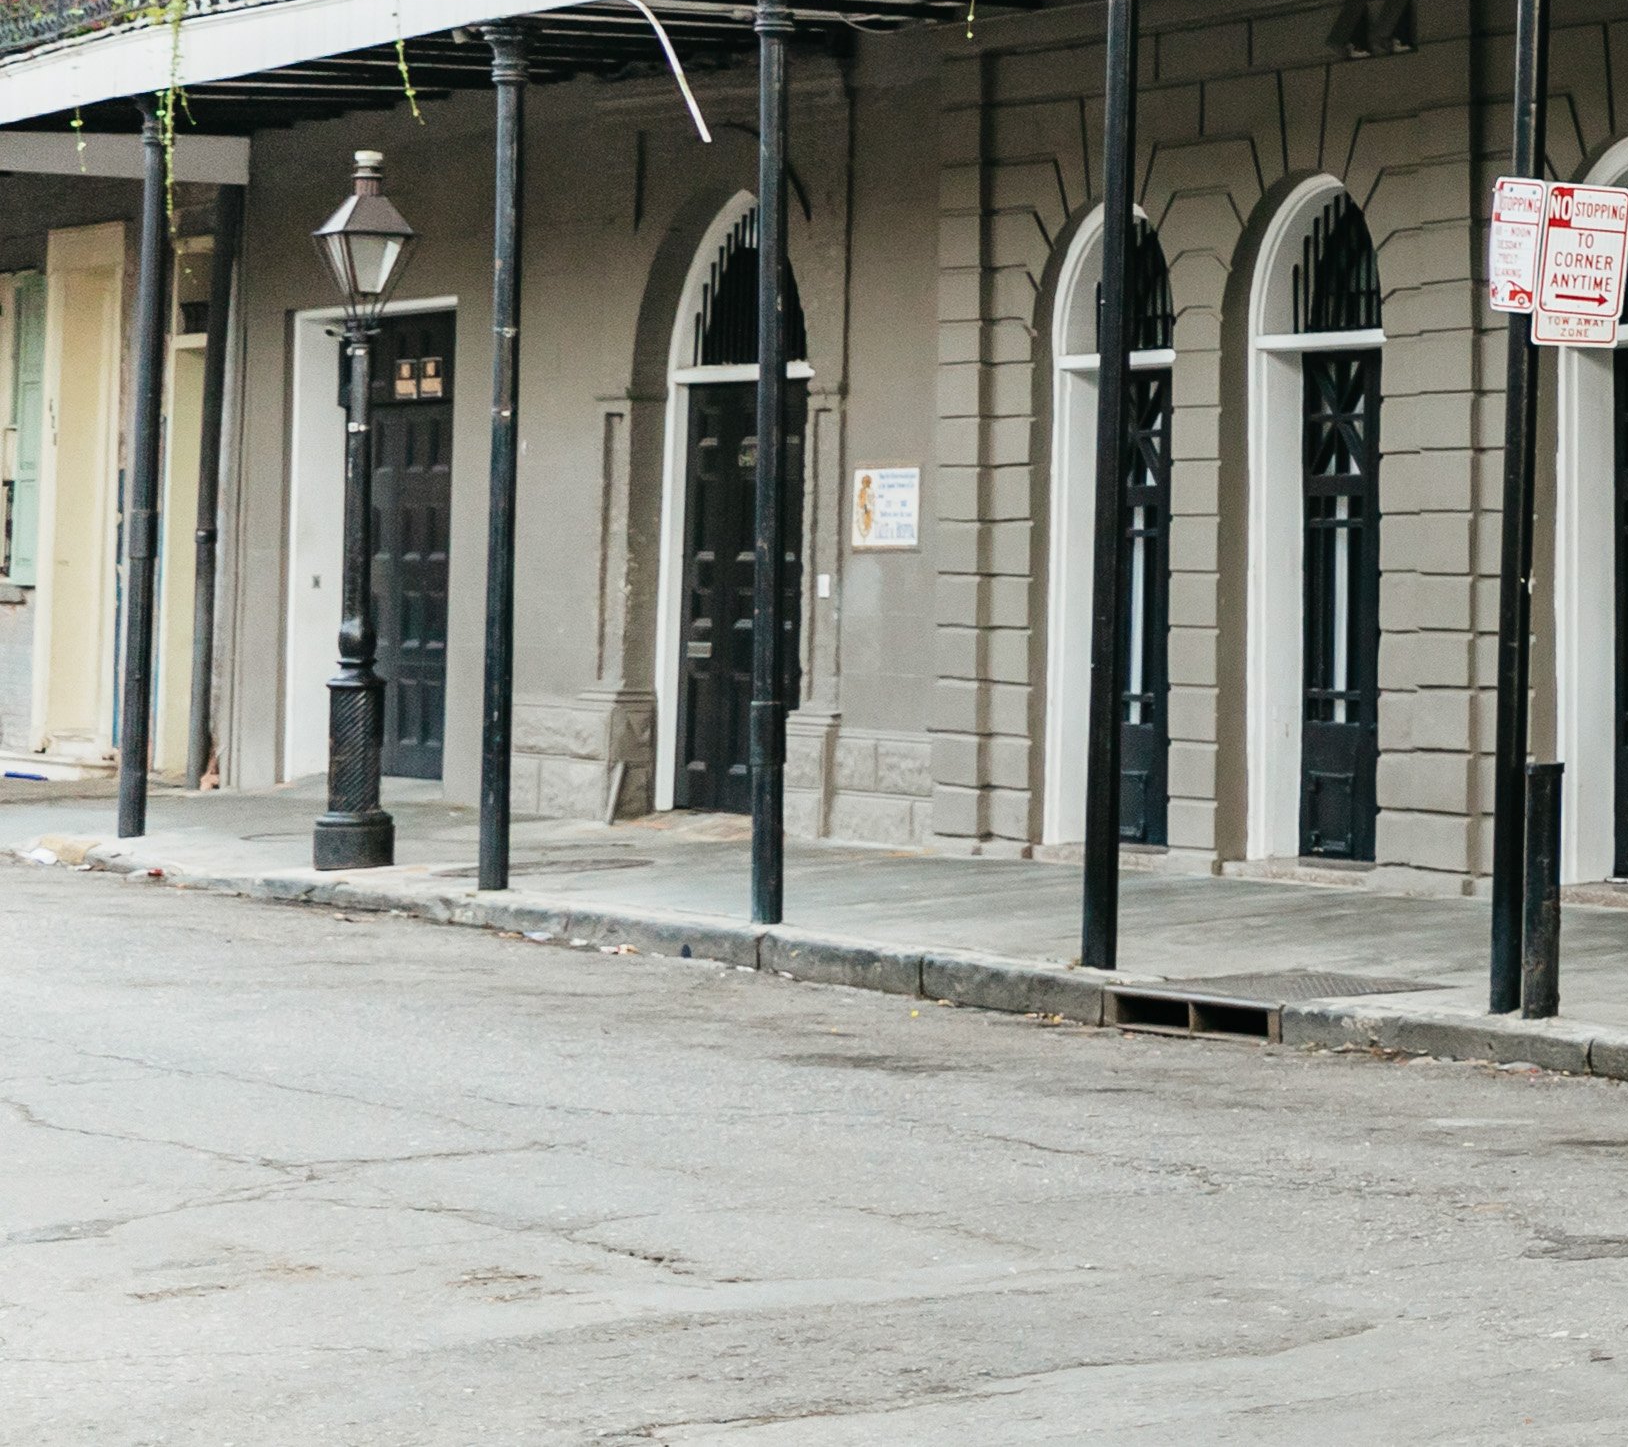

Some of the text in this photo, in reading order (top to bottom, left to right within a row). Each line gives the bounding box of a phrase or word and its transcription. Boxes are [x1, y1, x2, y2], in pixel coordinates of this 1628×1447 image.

[1550, 195, 1625, 221] NO STOPPING
[1577, 233, 1594, 249] TO
[1554, 252, 1614, 271] CORNER
[1550, 273, 1613, 293] ANYTIME
[1548, 315, 1605, 327] TOW AWAY
[1560, 327, 1590, 338] ZONE
